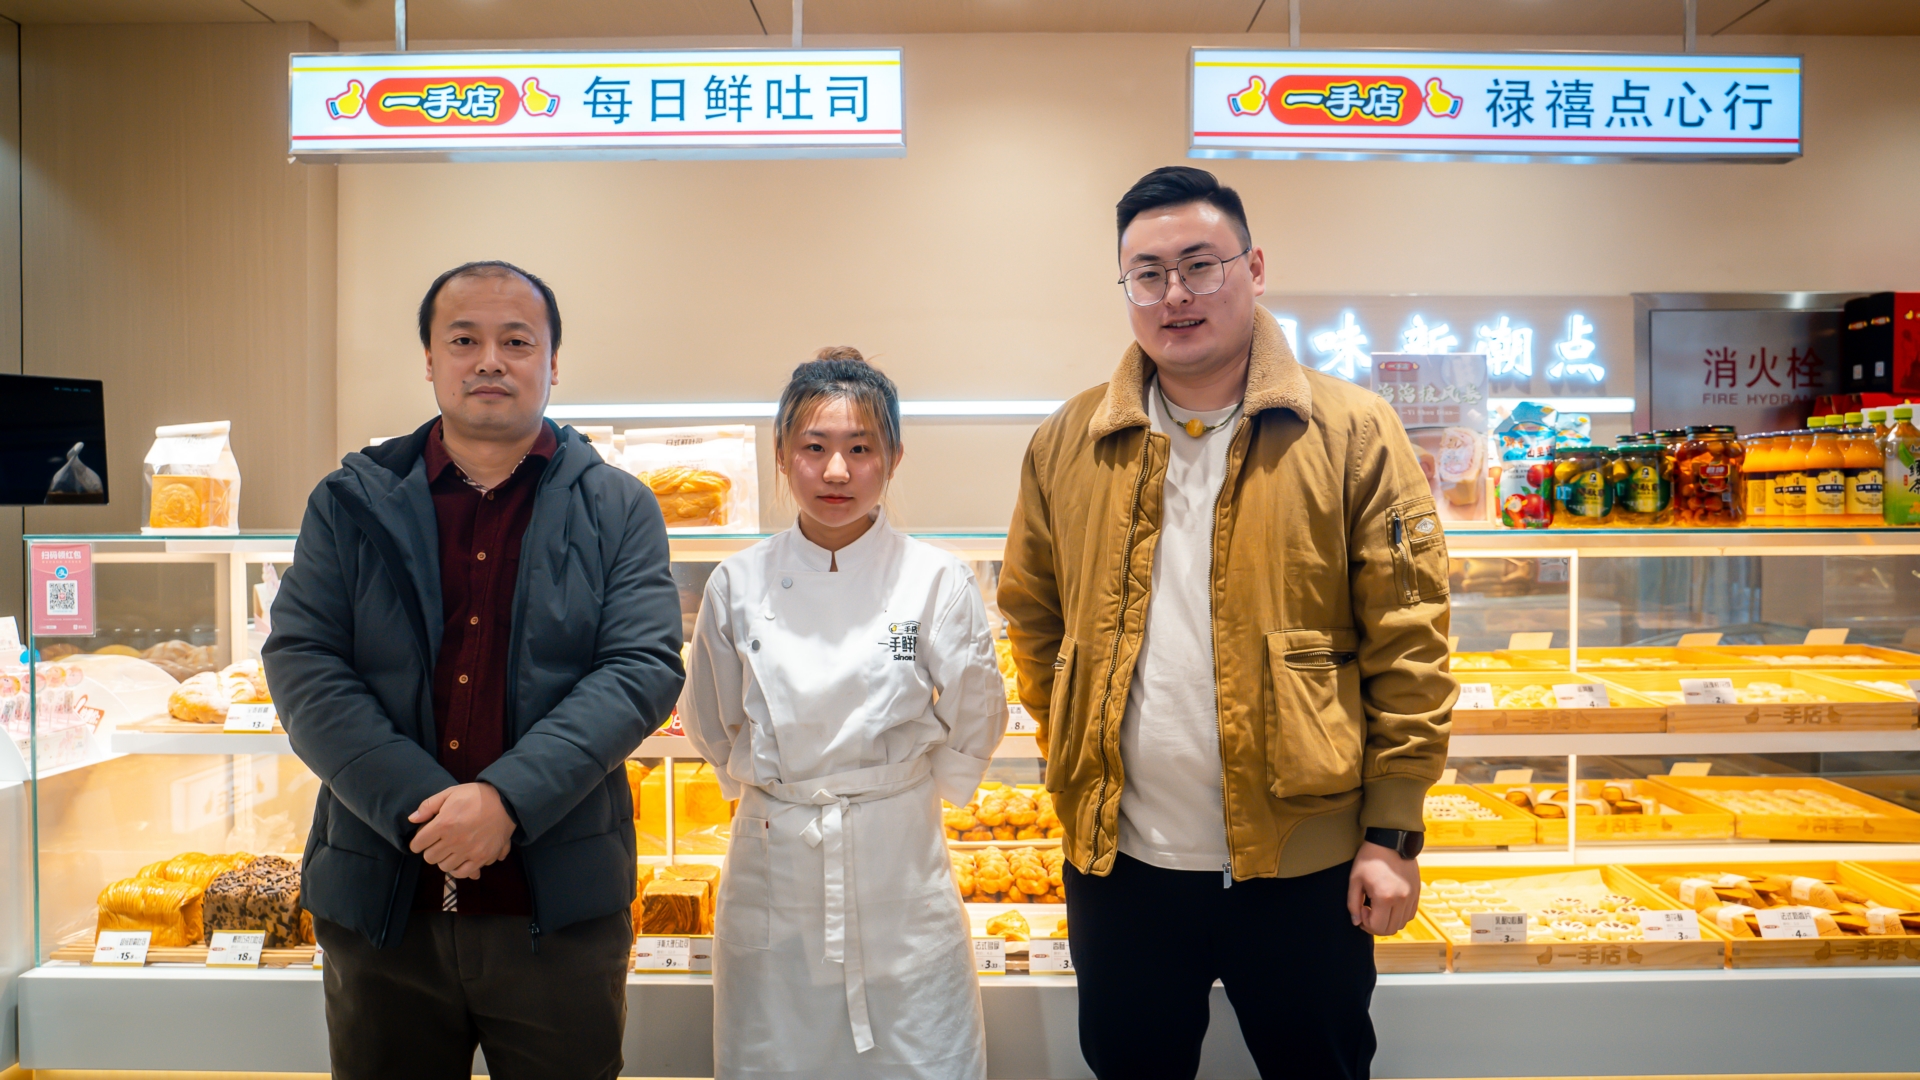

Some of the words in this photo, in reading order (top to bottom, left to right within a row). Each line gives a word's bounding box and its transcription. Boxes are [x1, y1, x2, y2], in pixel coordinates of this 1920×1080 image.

[382, 85, 500, 119] 一手店
[583, 74, 870, 124] 每日鲜吐司
[1286, 84, 1403, 119] 一手店
[1486, 79, 1773, 130] 禄禧点心行
[1703, 347, 1824, 389] 消火栓
[1703, 393, 1738, 405] FIRE
[41, 551, 82, 560] 扫码领红包
[1764, 706, 1822, 724] 一手店
[1558, 945, 1621, 965] 一手店
[1836, 940, 1899, 960] 一手店
